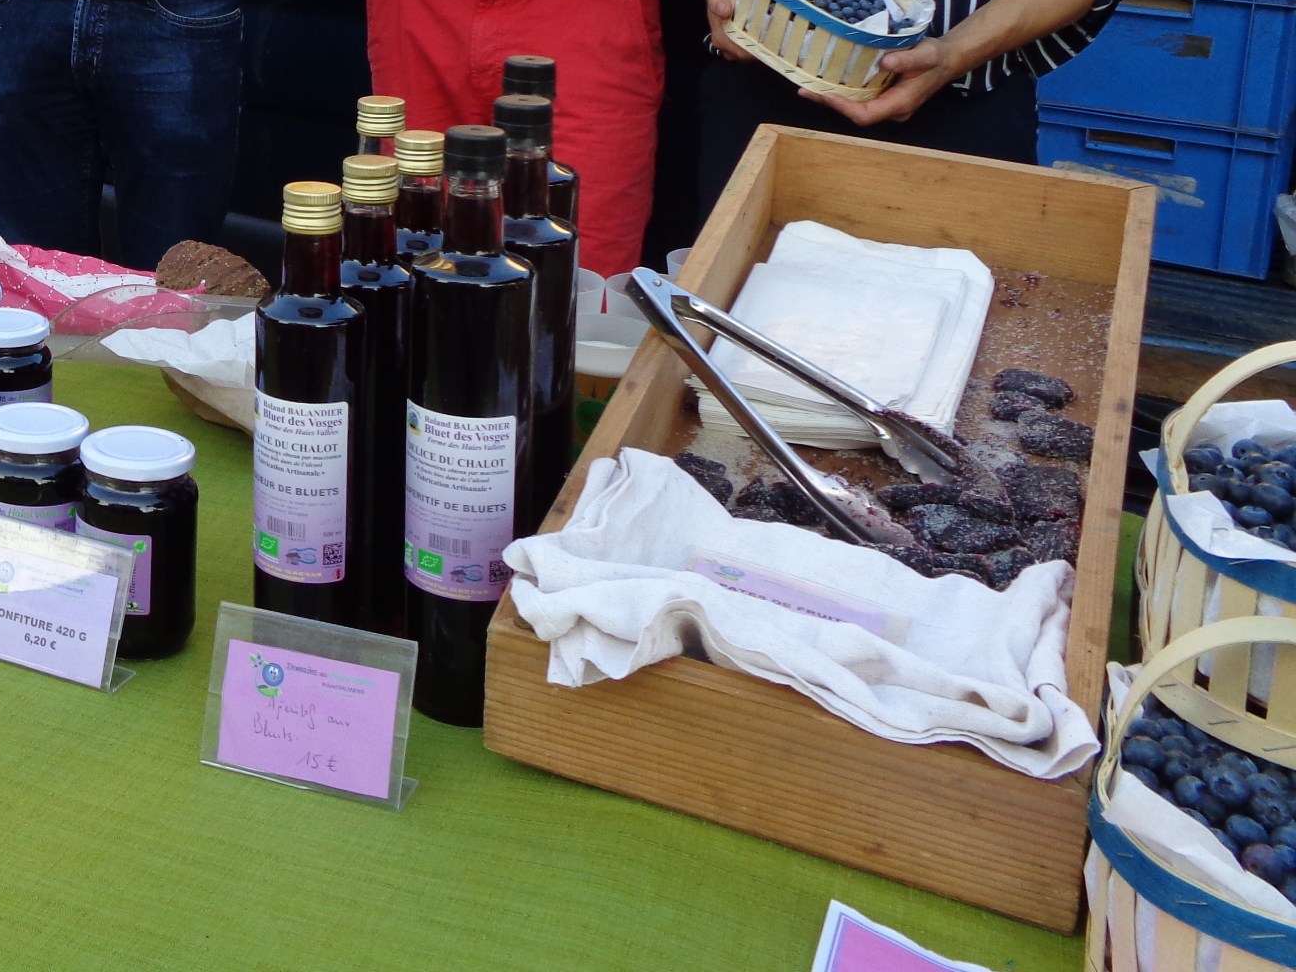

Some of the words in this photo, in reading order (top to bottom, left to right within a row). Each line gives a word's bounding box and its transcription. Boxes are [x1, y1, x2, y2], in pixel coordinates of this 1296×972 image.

[263, 408, 284, 423] Bluet
[288, 416, 305, 426] des
[308, 418, 343, 428] Vosges
[288, 407, 343, 417] BALANDIER
[424, 424, 451, 439] Bluet
[454, 431, 472, 441] des
[476, 432, 510, 443] Vosges
[454, 422, 510, 431] BALANDIER
[275, 439, 288, 449] DU
[291, 443, 338, 453] CHALOT
[439, 454, 454, 465] DU
[457, 458, 506, 468] CHALOT
[278, 484, 292, 494] DE
[295, 487, 339, 497] BLUETS
[444, 501, 459, 511] DE
[462, 503, 507, 513] BLUETS
[797, 607, 847, 622] FRUIT
[55, 625, 76, 638] 420
[79, 630, 87, 642] G
[24, 634, 47, 648] 6,20
[50, 640, 57, 650] €
[296, 751, 323, 769] 15
[326, 756, 338, 772] €
